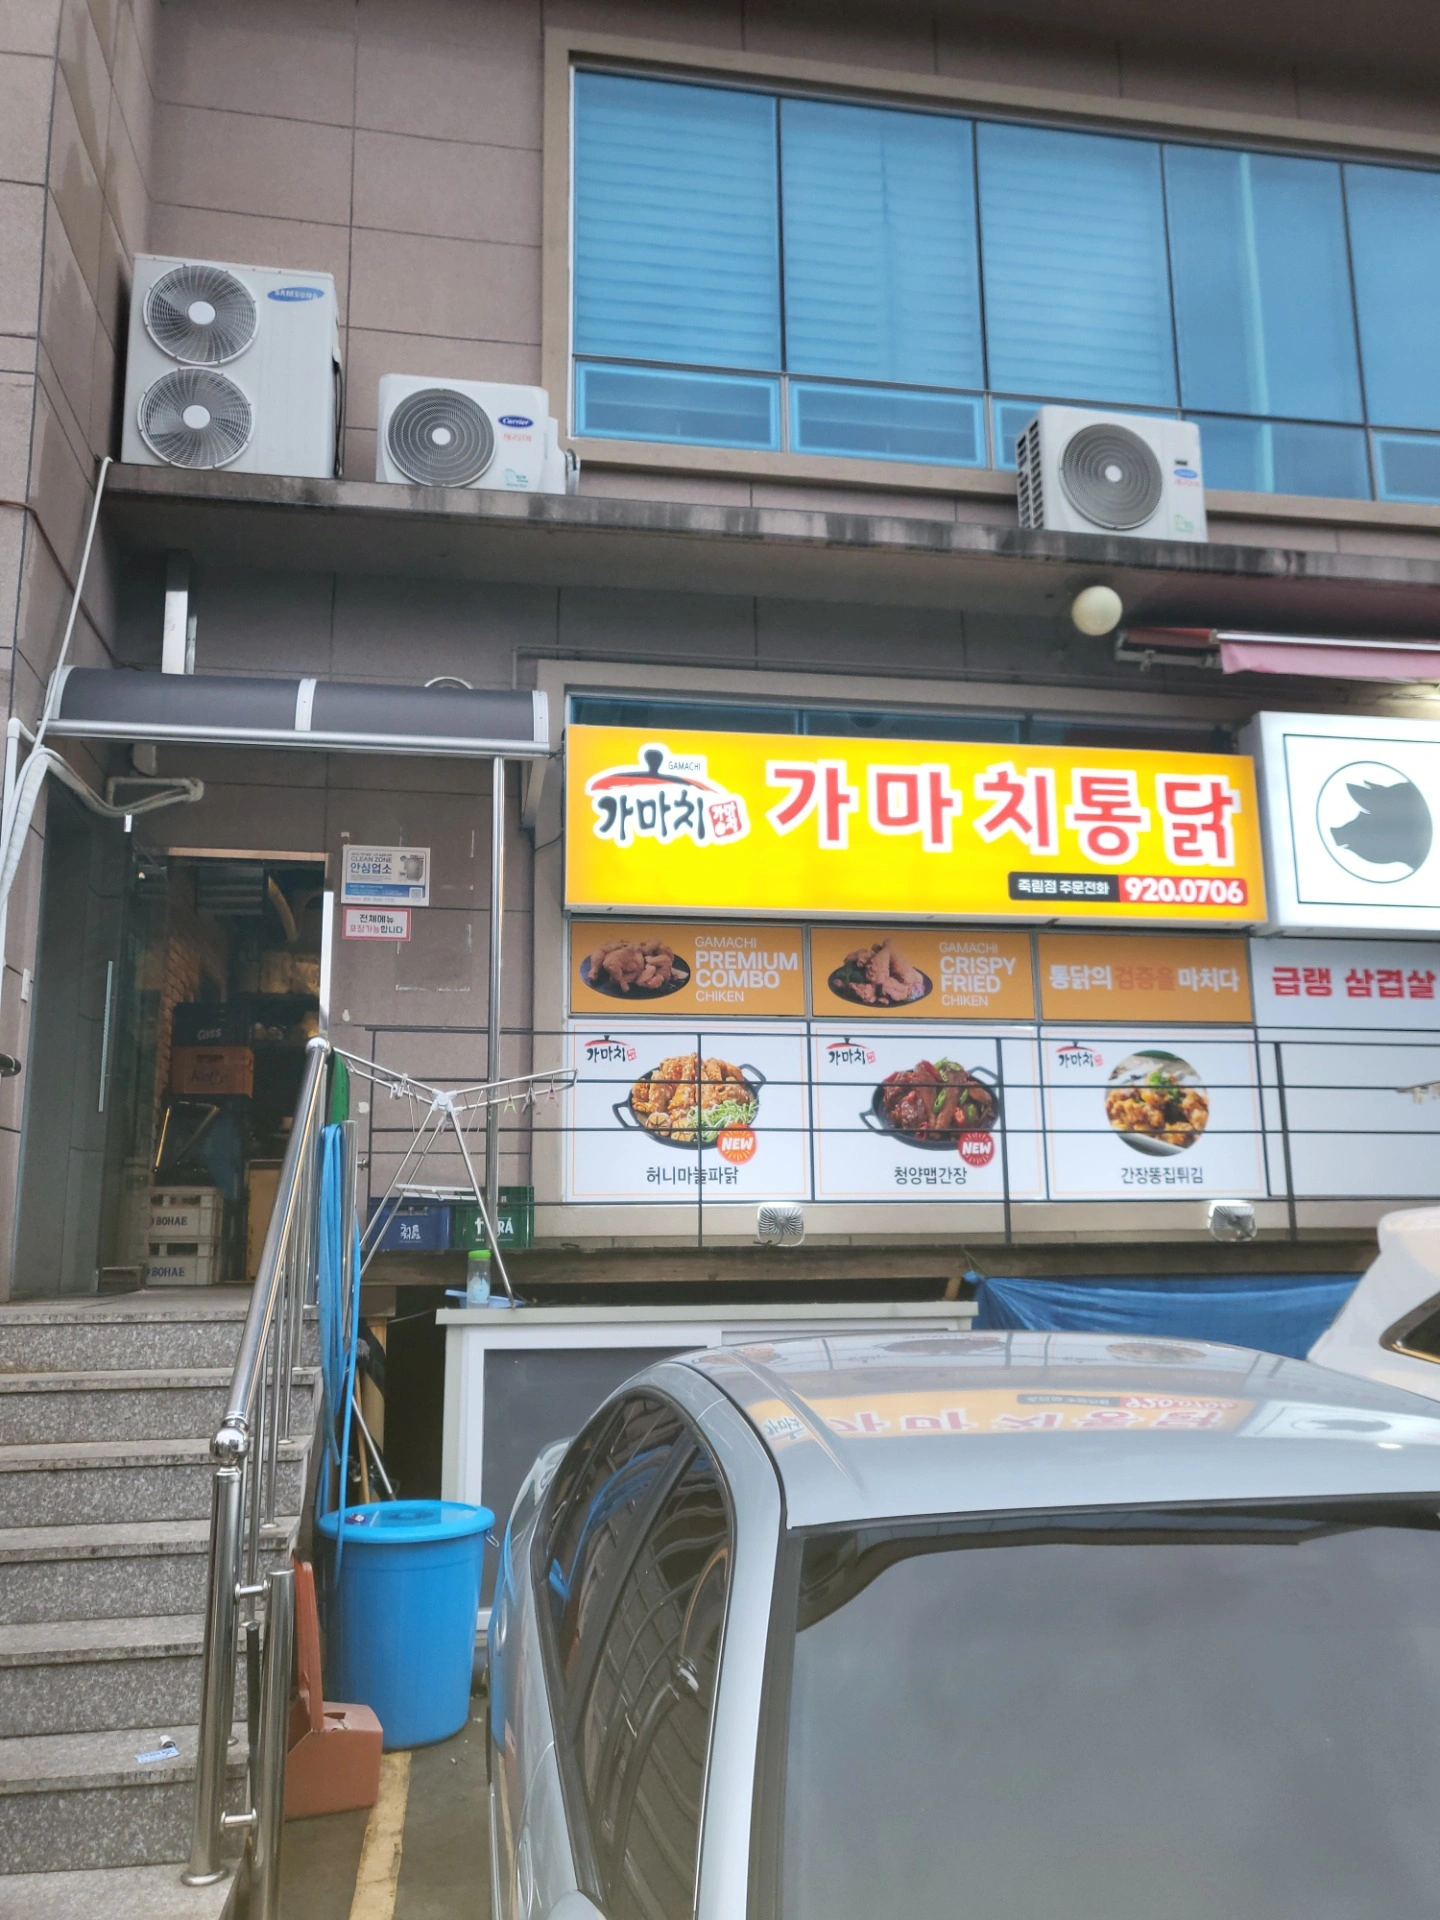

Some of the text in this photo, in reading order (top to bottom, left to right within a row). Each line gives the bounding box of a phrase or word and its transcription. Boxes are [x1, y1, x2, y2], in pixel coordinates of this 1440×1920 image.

[668, 760, 701, 771] GAMACHI
[598, 789, 705, 841] 가마치
[772, 766, 1234, 860] 가마치통닭
[350, 863, 393, 875] 안심업소
[1018, 878, 1110, 896] 죽림점 주문전화
[1125, 877, 1244, 904] 920.0706
[695, 936, 757, 949] GAMACHI
[939, 942, 998, 954] GAMACHI
[695, 951, 798, 970] PREMIUM
[940, 956, 1016, 975] CRISPY
[695, 969, 780, 989] COMBO
[941, 974, 1001, 993] FRIED
[1050, 965, 1112, 990] 통닭의
[1178, 968, 1239, 992] 마치다
[1344, 968, 1436, 998] 삼겹살
[695, 990, 744, 1002] CHIKEN
[942, 995, 988, 1006] CHIKEN
[587, 1045, 626, 1062] 가마치
[828, 1048, 866, 1065] 가마치
[1058, 1052, 1094, 1068] 가마치
[721, 1138, 753, 1151] NEW
[961, 1142, 992, 1155] NEW
[646, 1166, 739, 1185] 허니마늘파닭
[1121, 1166, 1204, 1185] 간장똥집튀김
[156, 1216, 188, 1226] BOHAE
[151, 1267, 185, 1277] BOHAE
